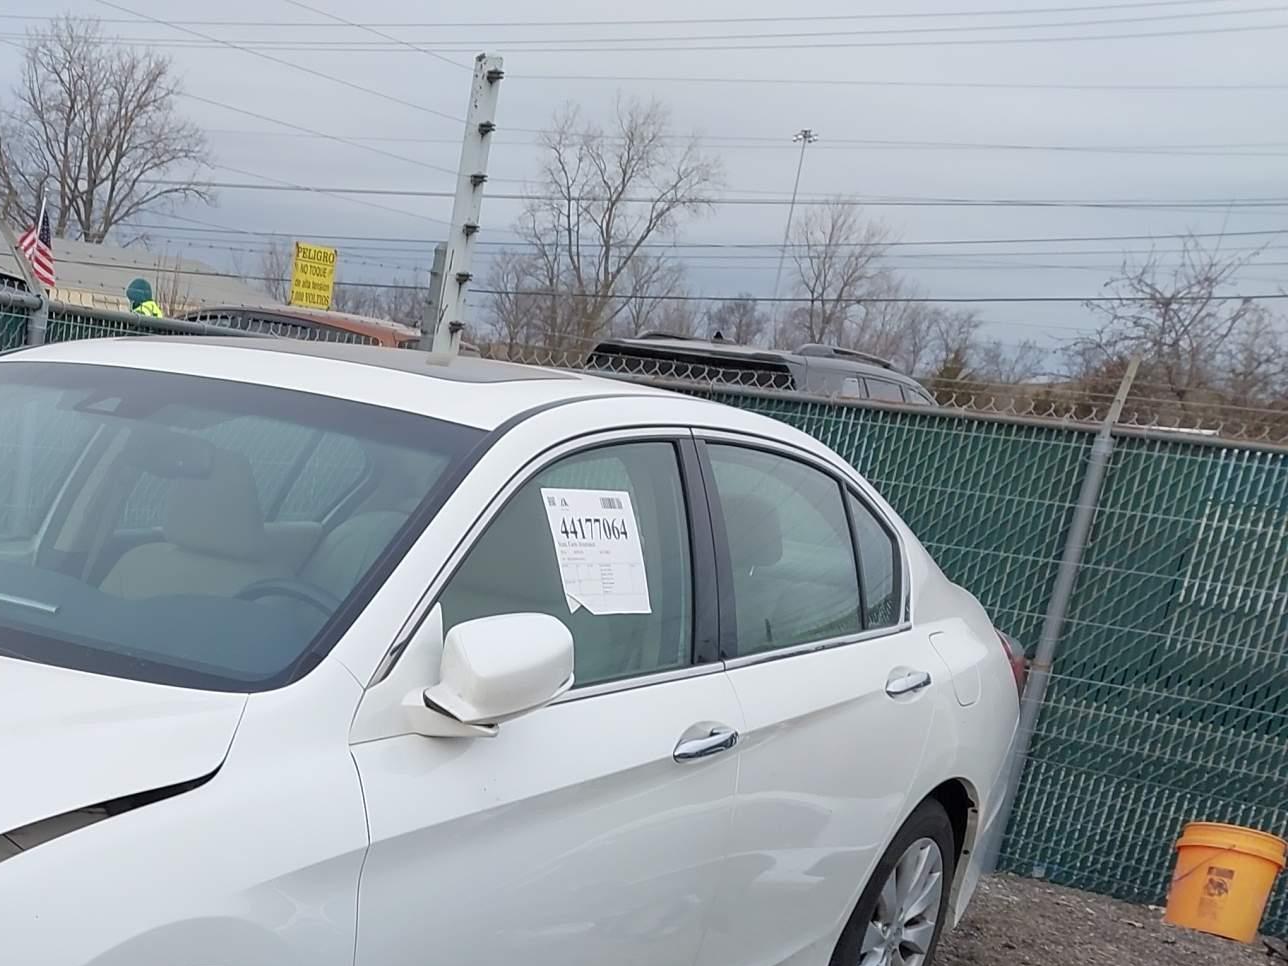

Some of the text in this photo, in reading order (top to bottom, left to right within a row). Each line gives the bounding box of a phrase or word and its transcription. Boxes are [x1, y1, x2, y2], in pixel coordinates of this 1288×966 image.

[297, 246, 335, 264] PELIGRO
[300, 264, 327, 278] NO TOQUE
[305, 292, 330, 306] VOLTIOS
[560, 517, 628, 540] 44177064
